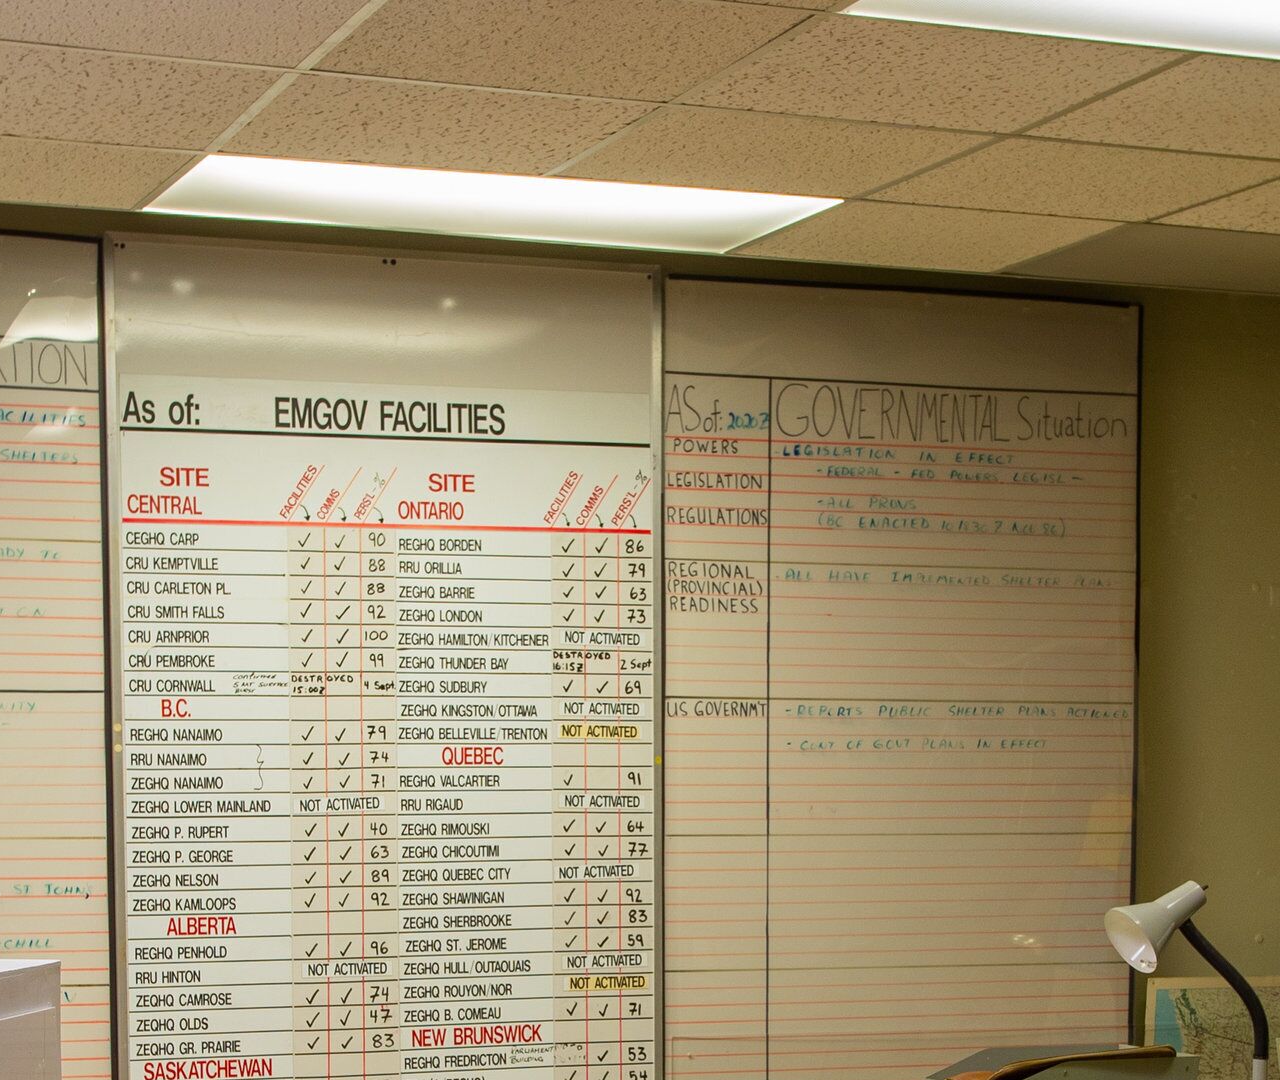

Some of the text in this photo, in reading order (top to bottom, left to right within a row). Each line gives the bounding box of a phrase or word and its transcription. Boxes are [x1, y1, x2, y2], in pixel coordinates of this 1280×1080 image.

[123, 391, 199, 425] As of:
[275, 397, 505, 435] EMGOV FACILITIES
[664, 384, 701, 433] AS
[776, 383, 1127, 443] GOVERNMENTAL Situation
[673, 438, 738, 455] POWERS
[160, 467, 209, 486] SITE
[429, 473, 475, 492] SITE
[667, 472, 762, 490] LEGISLATION
[279, 464, 318, 519] FACILITIES
[543, 470, 579, 524] FACILITIES
[127, 494, 202, 515] CENTRAL
[317, 488, 341, 520] COMMS
[398, 501, 464, 520] ONTARIO
[576, 485, 604, 526] COMMS
[611, 490, 637, 526] PERS'L
[667, 506, 767, 525] REGULATIONS
[125, 532, 199, 546] CEGHQ CARP
[369, 532, 385, 547] 90
[399, 539, 481, 551] REGHQ BORDEN
[626, 539, 644, 553] 86
[126, 557, 218, 570] CRU KEMPTVILLE
[399, 561, 462, 574] RRU ORILLIA
[628, 563, 645, 577] 79
[669, 561, 755, 580] REGIONAL
[127, 581, 231, 595] CRU CARLETON PL.
[667, 578, 763, 597] (PROVINCIAL)
[128, 605, 224, 619] CRU SMITH FALLS
[669, 595, 759, 614] READINESS
[399, 609, 482, 622] ZEGHQ LONDON
[128, 630, 209, 643] CRU ARNPRIOR
[565, 631, 640, 645] NOT ACTIVATED
[129, 653, 215, 667] CRU PEMBROKE
[399, 657, 508, 669] ZEGHQ THUNDER BAY
[129, 679, 215, 692] CRU CORNWALL
[162, 699, 191, 717] B.C.
[667, 700, 688, 718] US
[131, 729, 222, 741] REGHQ NANAIMO
[441, 747, 504, 766] QUEBEC
[400, 775, 499, 787] REGHQ VALCARTIER
[132, 800, 271, 813] ZEGHQ LOWER MAINLAND
[300, 797, 379, 812] NOT ACTIVATED
[402, 845, 499, 858] ZEGHQ CHICOUTIMI
[133, 874, 218, 887] ZEGHQ NELSON
[133, 898, 236, 911] ZEGHQ KAMLOOPS
[403, 892, 504, 905] ZEGHQ SHAWINIGAN
[167, 917, 236, 935] ALBERTA
[135, 946, 227, 960] REGHQ PENHOLD
[136, 970, 200, 984] RRU HINTON
[412, 1024, 542, 1047] NEW BRUNSWICK
[137, 1040, 240, 1056] ZEQHQ GR. PRAIRIE
[144, 1058, 272, 1080] SASKATCHEWAN
[405, 1053, 506, 1069] REGHQ FREDRICTON
